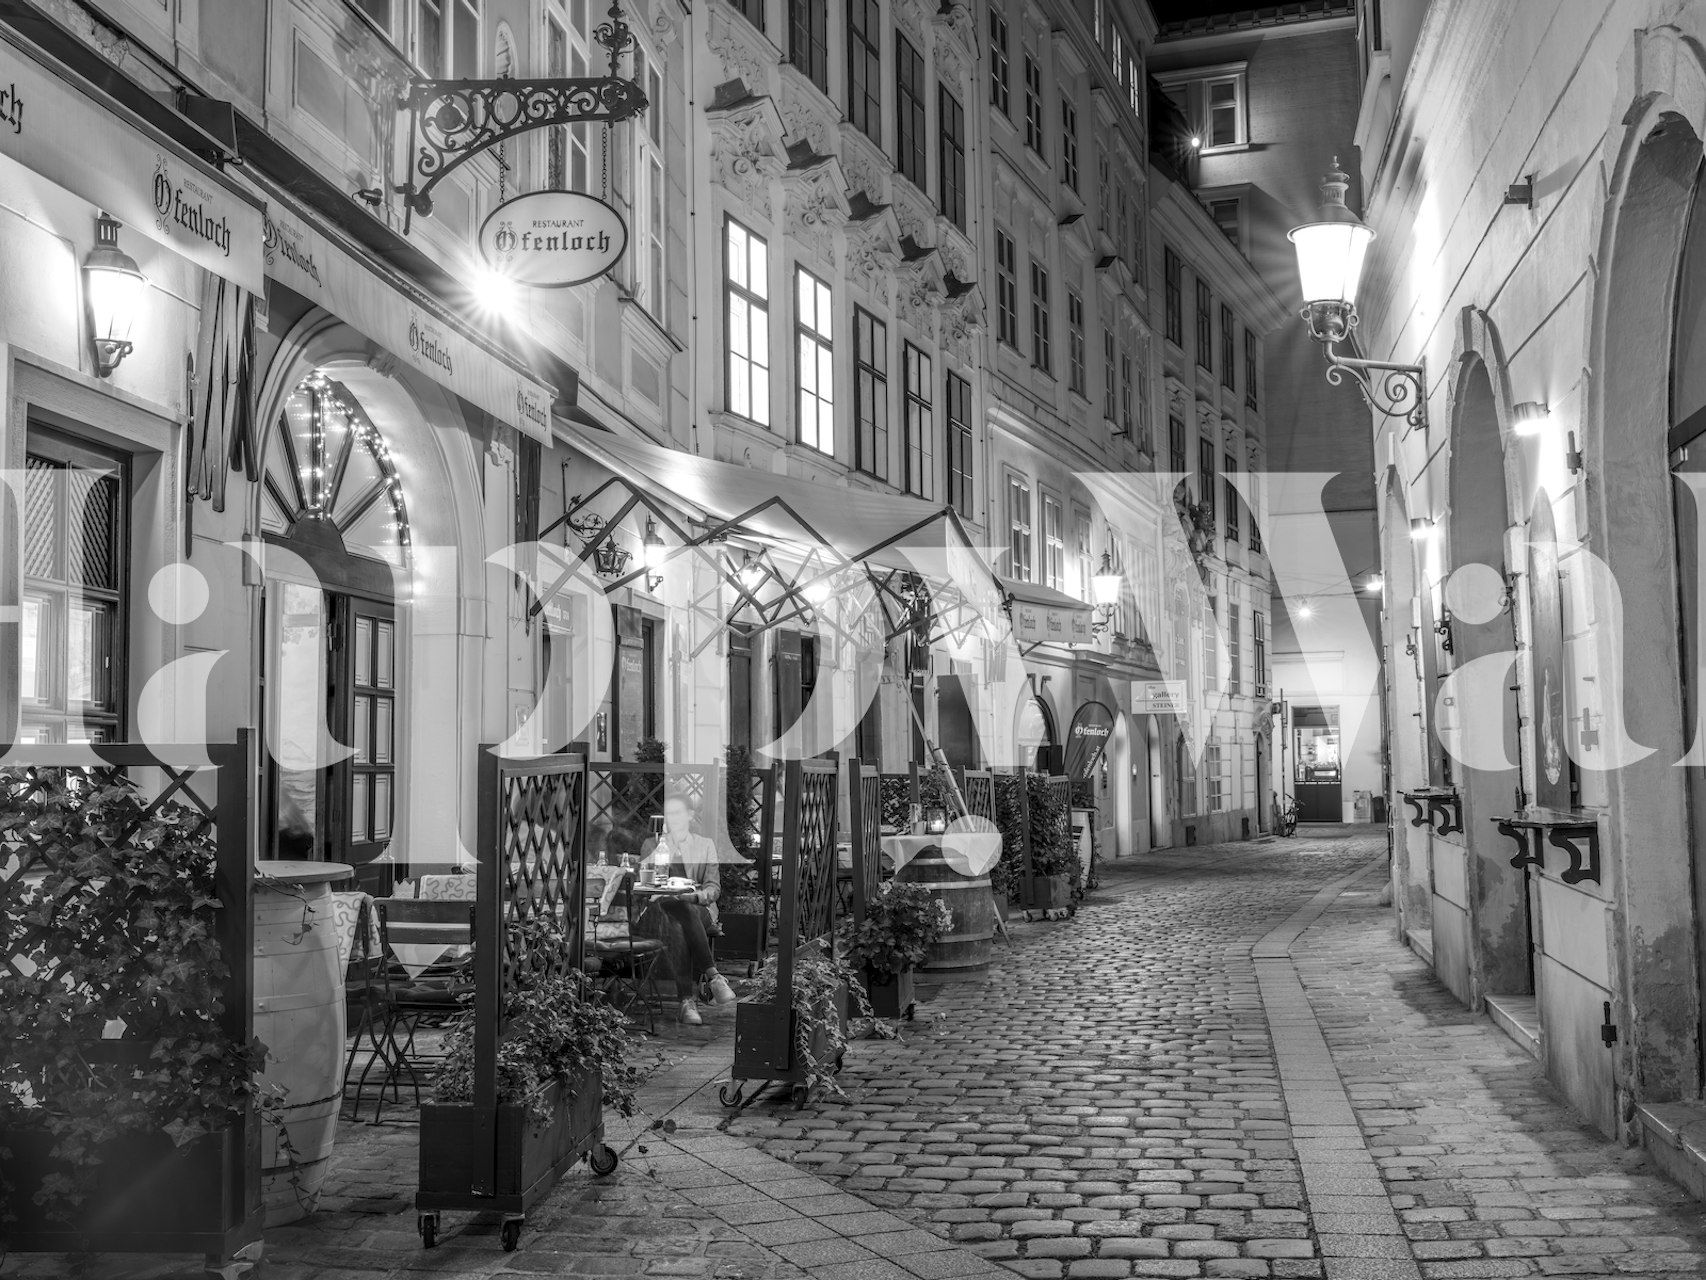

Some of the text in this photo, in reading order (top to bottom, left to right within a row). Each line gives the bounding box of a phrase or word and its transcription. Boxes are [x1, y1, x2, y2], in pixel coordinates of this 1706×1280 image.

[183, 178, 213, 205] RESTAURANT
[154, 172, 231, 257] Ofenloch
[533, 219, 584, 228] RESTAURANT
[494, 229, 611, 254] Ofenloch
[409, 321, 453, 376] Ofenloch
[1152, 691, 1180, 700] gallery
[1075, 725, 1109, 737] Ofenloch
